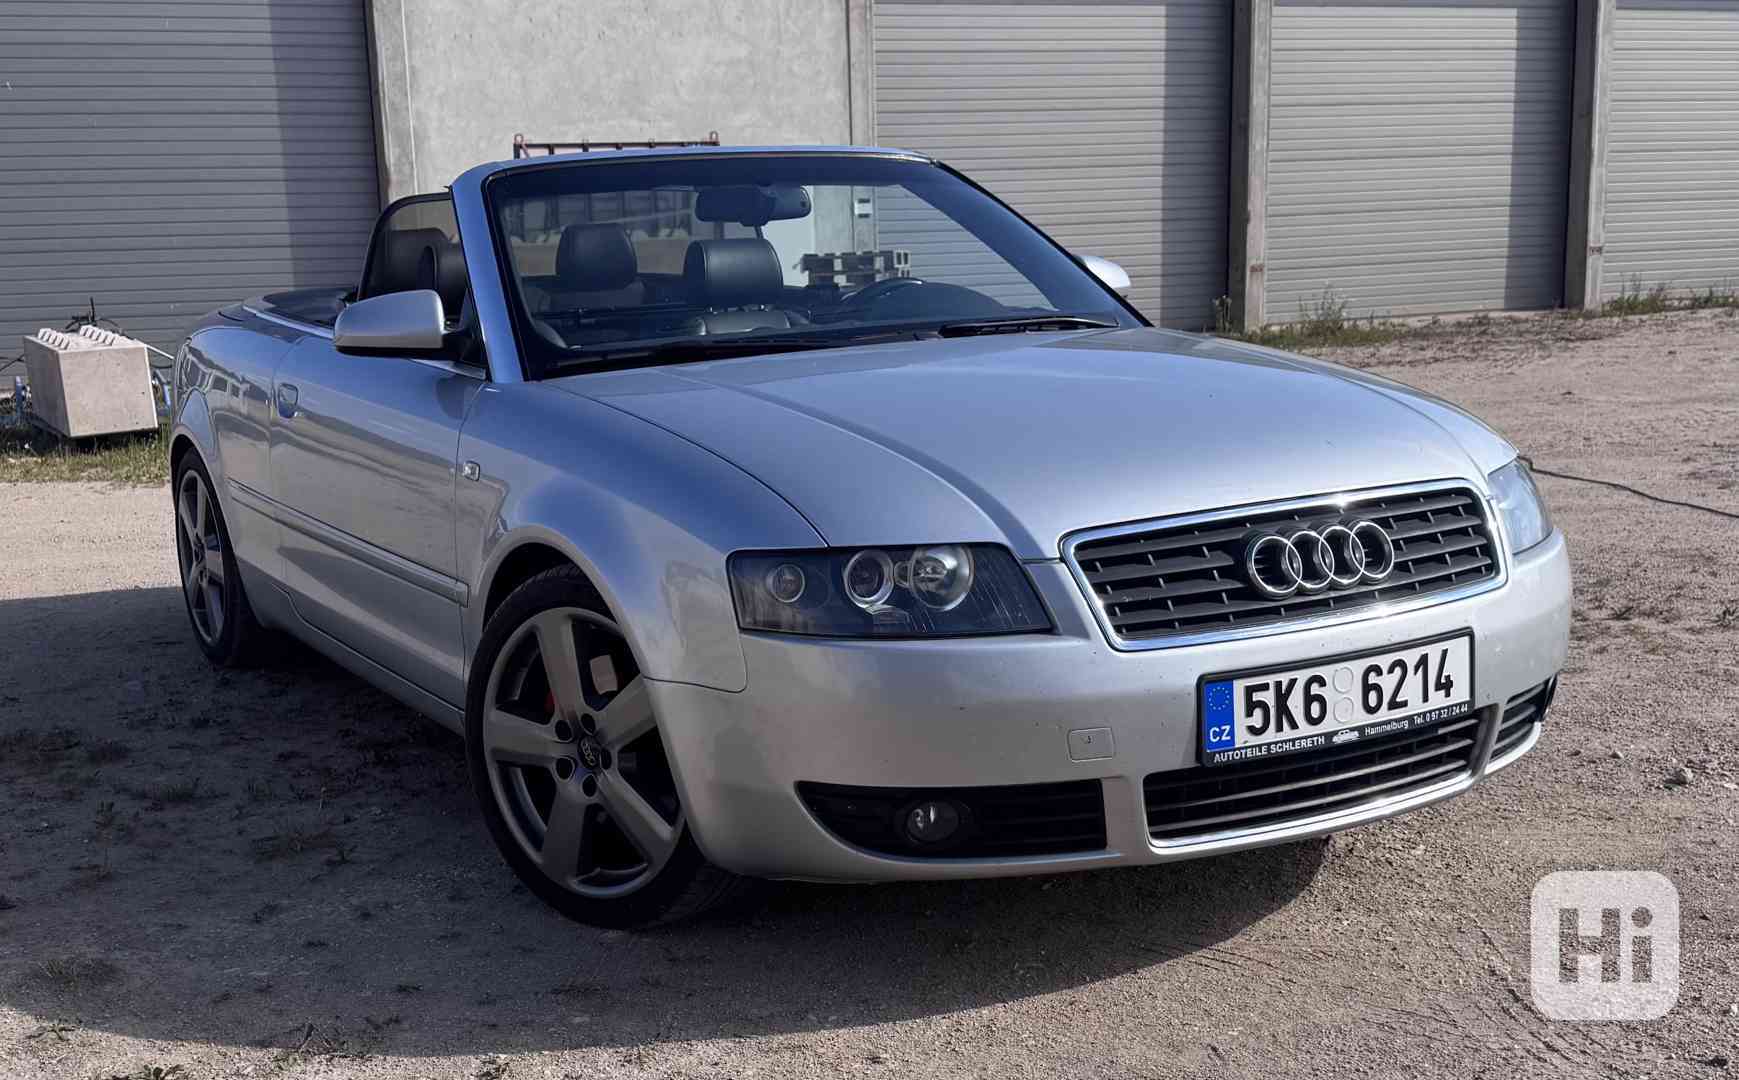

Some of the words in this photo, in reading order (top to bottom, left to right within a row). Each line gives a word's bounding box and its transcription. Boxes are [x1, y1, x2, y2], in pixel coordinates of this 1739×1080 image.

[1243, 674, 1328, 737] 5K6
[1361, 647, 1454, 715] 6214
[1209, 724, 1232, 742] CZ
[1365, 720, 1409, 736] Hammelburg
[1413, 715, 1425, 725] Tel.
[1213, 745, 1268, 763] AUTOTEILE
[1270, 735, 1325, 753] SCHLERETH
